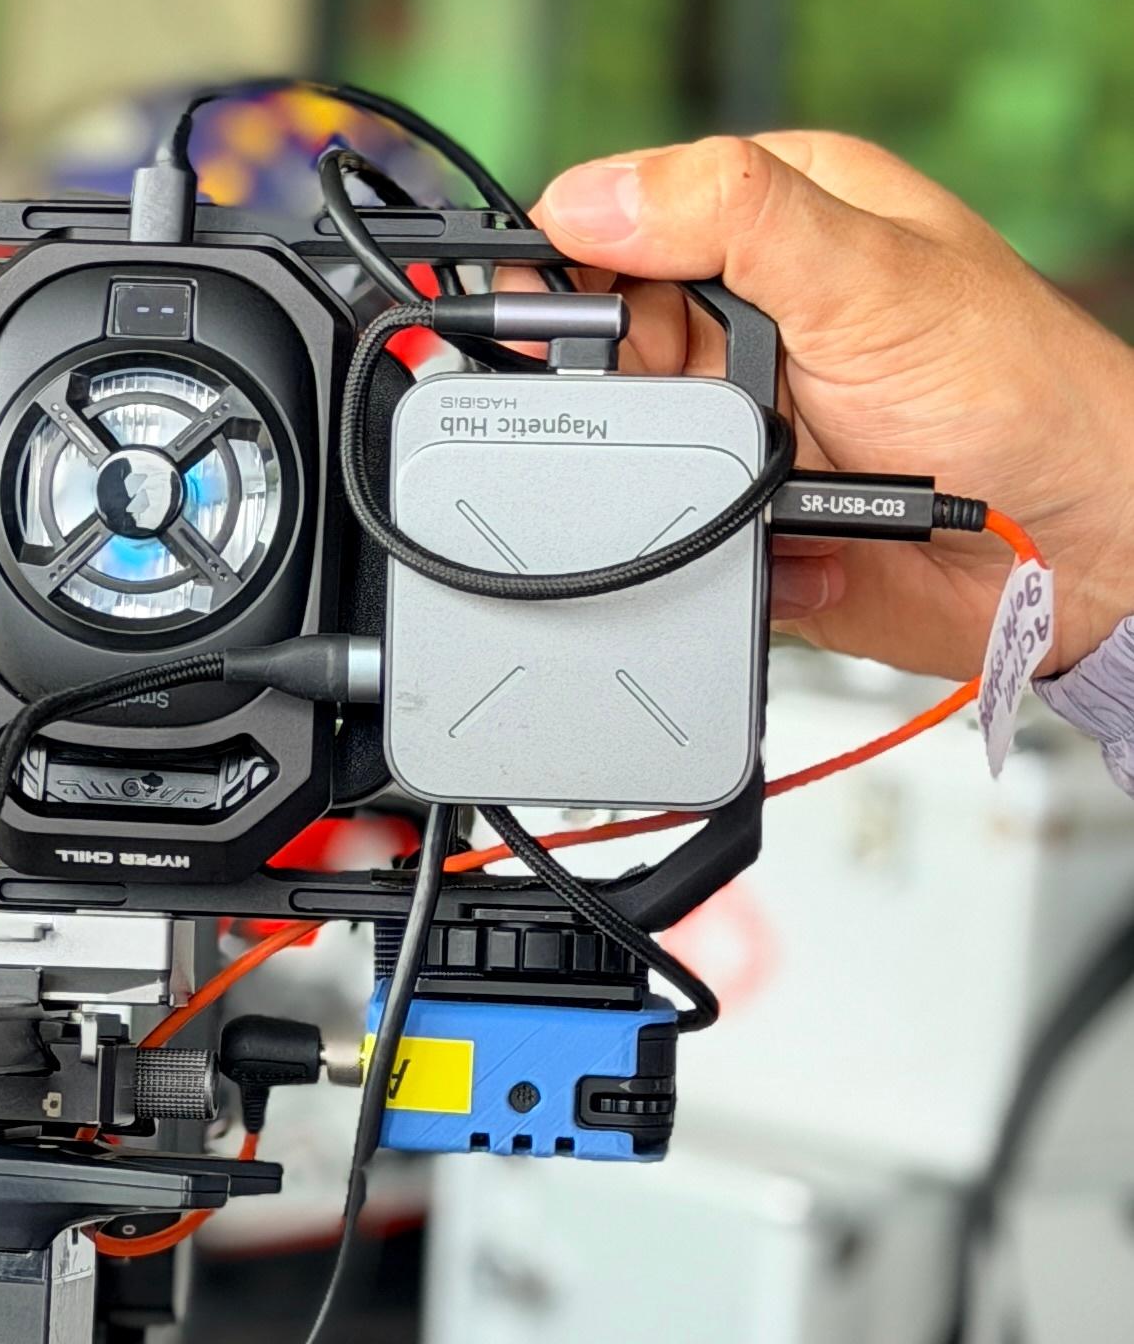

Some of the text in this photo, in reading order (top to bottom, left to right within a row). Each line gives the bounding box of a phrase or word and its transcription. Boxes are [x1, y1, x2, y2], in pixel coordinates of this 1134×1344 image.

[440, 413, 608, 439] Magnetic Hub
[800, 494, 906, 517] SR-USB-C03
[54, 849, 190, 869] HYPER CHILL
